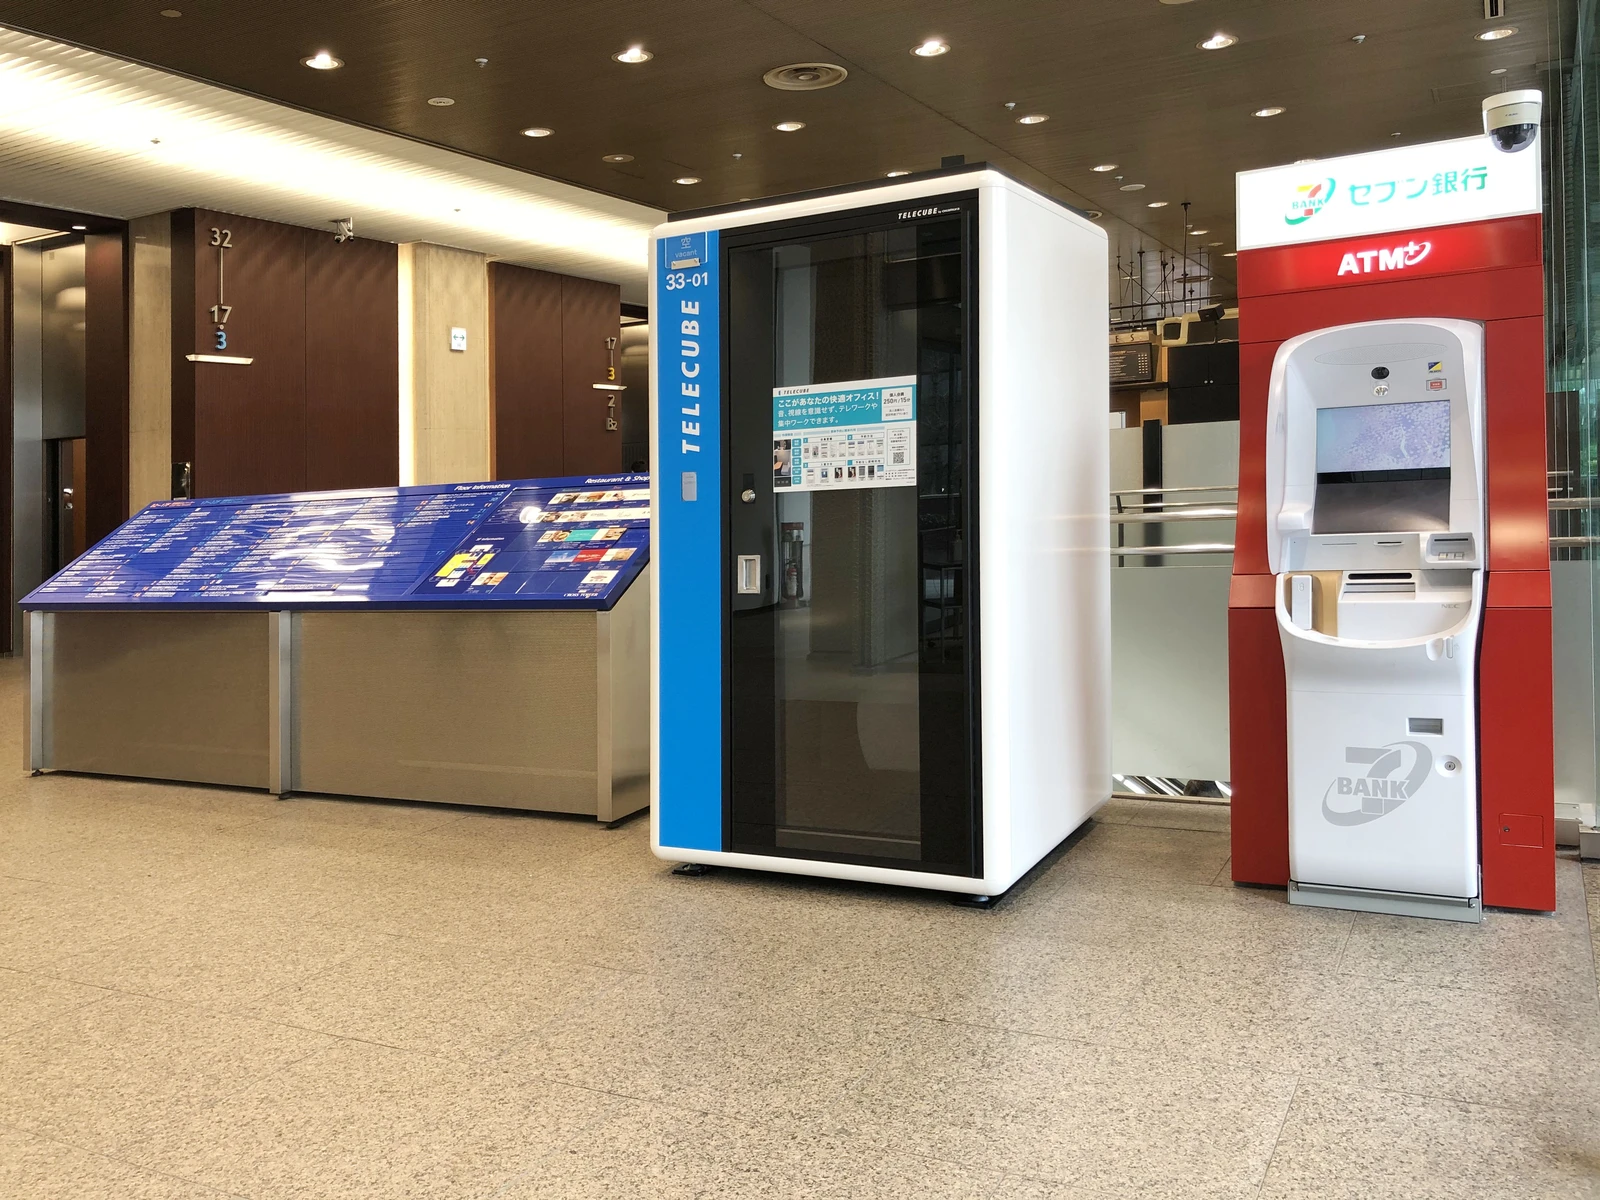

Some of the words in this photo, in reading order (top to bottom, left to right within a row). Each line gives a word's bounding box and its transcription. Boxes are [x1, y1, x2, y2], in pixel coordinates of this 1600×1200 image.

[1348, 166, 1488, 206] セブン銀行
[1291, 197, 1325, 210] BANK
[897, 207, 938, 220] TELECUBE
[210, 227, 233, 248] 32
[680, 236, 692, 249] 空
[674, 249, 698, 258] vacant
[665, 271, 709, 291] 33-01
[209, 304, 233, 323] 17
[215, 331, 227, 350] 3
[605, 336, 617, 350] 17
[607, 367, 616, 381] 3
[680, 300, 701, 455] TELECUBE
[607, 394, 616, 407] 2
[606, 417, 618, 431] B2
[585, 476, 624, 484] Restaurant
[1337, 776, 1409, 799] BANK
